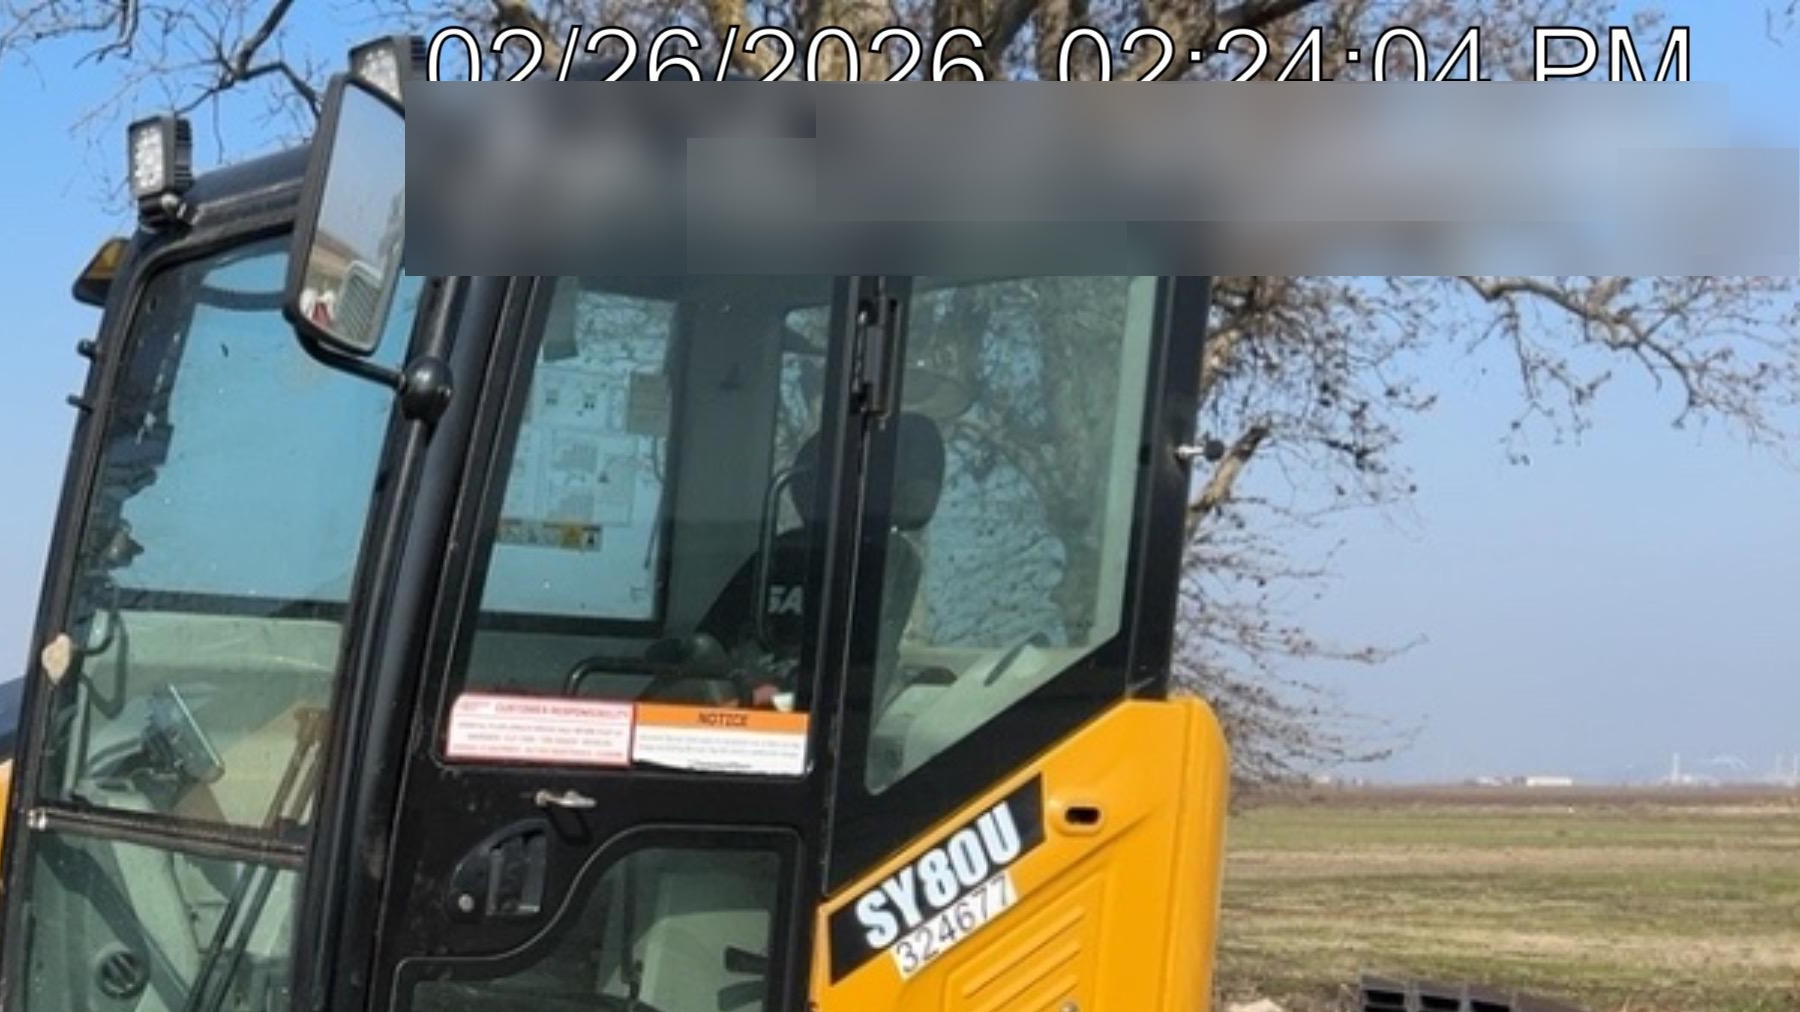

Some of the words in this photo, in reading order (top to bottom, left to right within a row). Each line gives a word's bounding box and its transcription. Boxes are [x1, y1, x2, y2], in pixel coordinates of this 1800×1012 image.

[698, 712, 749, 727] NOTICE
[856, 800, 1022, 949] SY80U
[896, 873, 1010, 973] 324677
